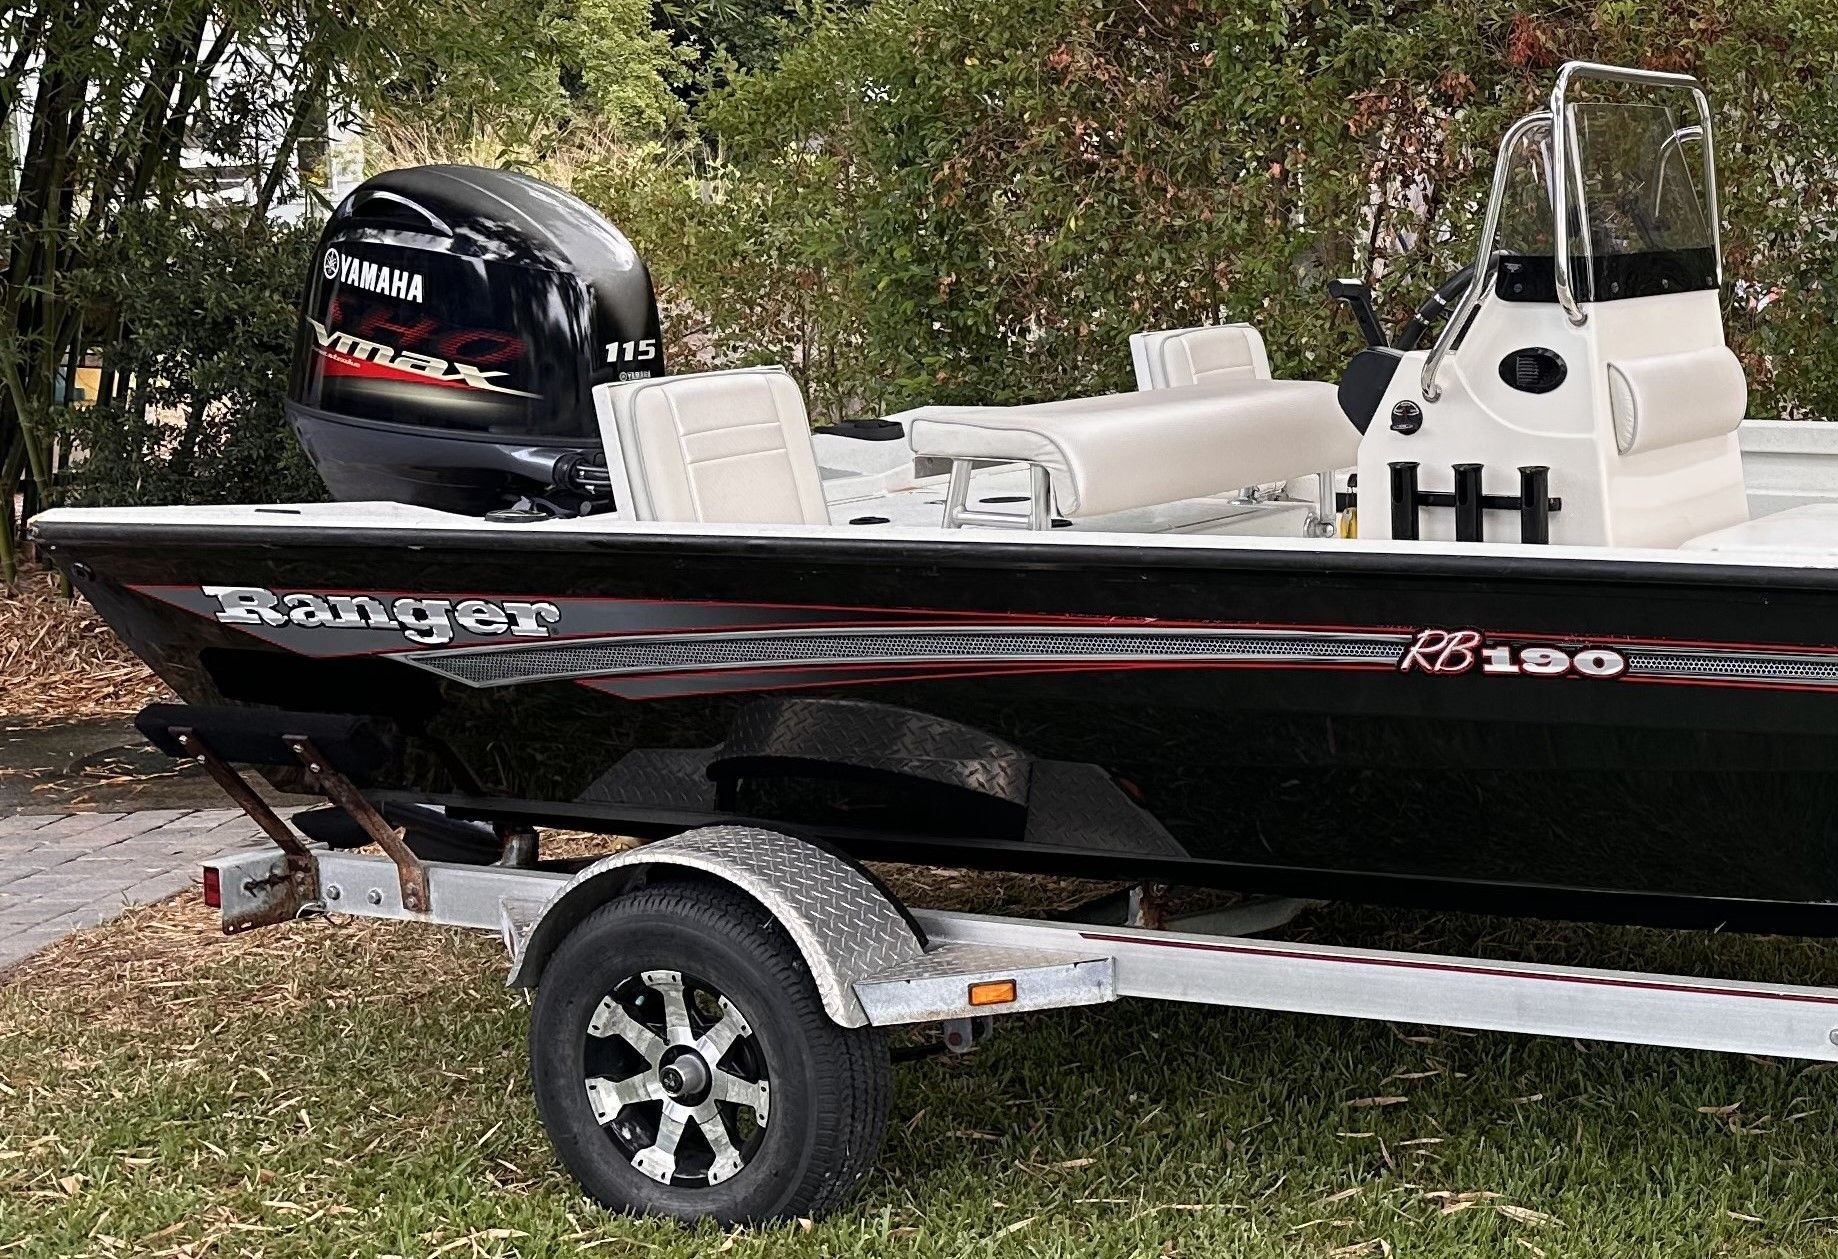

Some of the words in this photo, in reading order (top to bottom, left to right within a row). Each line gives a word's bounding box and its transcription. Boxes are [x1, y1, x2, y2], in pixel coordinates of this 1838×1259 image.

[340, 253, 424, 304] YAMAHA
[605, 339, 656, 363] 115
[201, 584, 558, 645] Ranger
[1400, 628, 1481, 673] RB
[1482, 645, 1625, 677] 190
